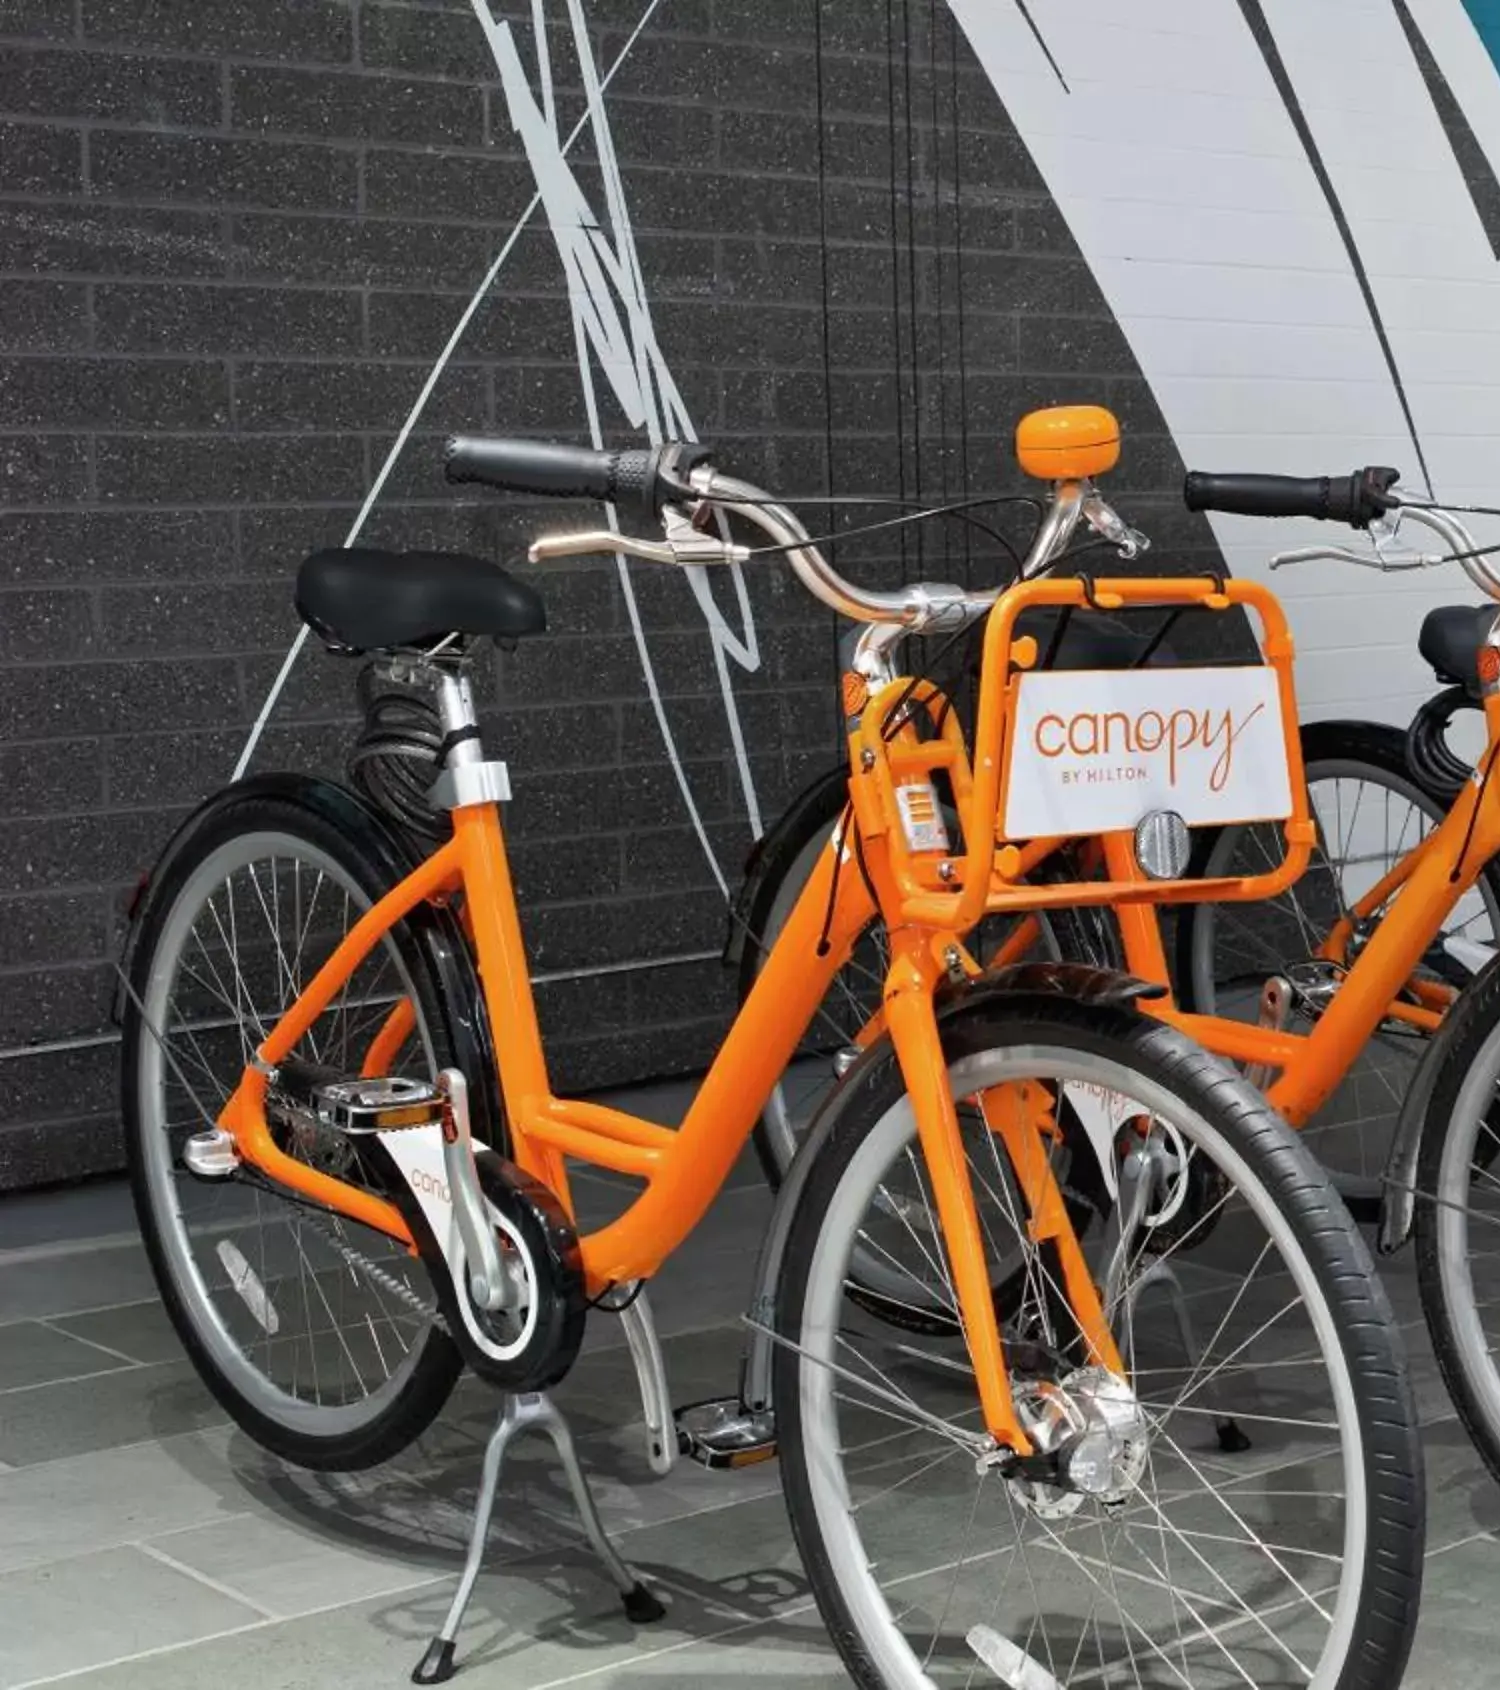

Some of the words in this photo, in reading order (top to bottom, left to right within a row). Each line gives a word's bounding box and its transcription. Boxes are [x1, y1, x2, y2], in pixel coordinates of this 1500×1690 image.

[1035, 703, 1264, 792] canopy
[1062, 771, 1081, 785] BY
[1087, 767, 1148, 782] HILTON
[411, 1169, 451, 1203] cano
